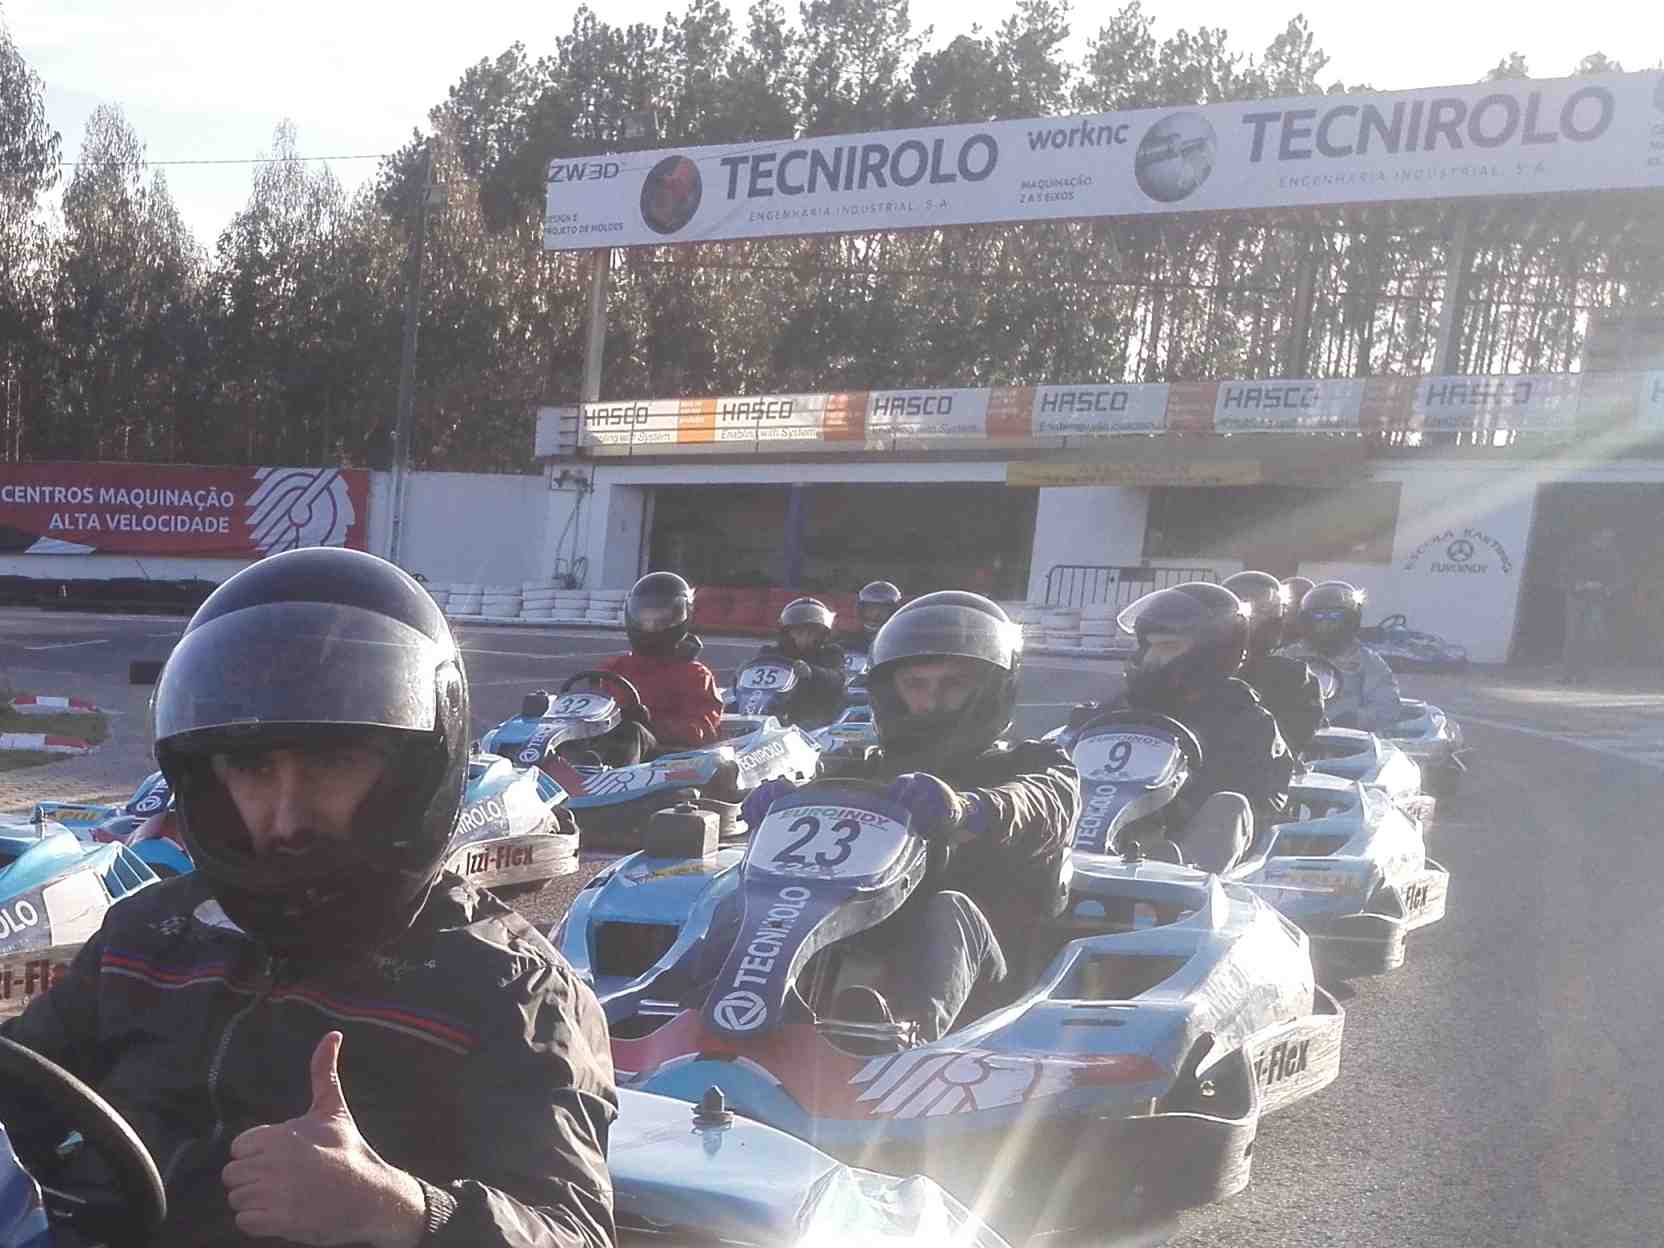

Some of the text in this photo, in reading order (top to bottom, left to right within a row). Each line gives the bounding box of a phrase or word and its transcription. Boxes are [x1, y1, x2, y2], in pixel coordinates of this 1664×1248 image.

[1240, 85, 1617, 163] TECNIROLO
[1027, 120, 1128, 152] worknc
[548, 163, 620, 183] ZW3D
[720, 133, 1000, 201] TECNIROLO
[873, 395, 953, 416] HASCO
[1039, 391, 1130, 412] HASCO
[1224, 386, 1318, 409] HASCO
[584, 405, 649, 427] HASCO
[722, 400, 794, 421] HASCO
[0, 485, 235, 509] CENTROS MAQUINAÇÃO
[48, 512, 230, 534] ALTA VELOCIDADE
[751, 668, 778, 685] 35
[559, 698, 590, 714] 32
[1104, 741, 1132, 773] 9
[771, 815, 862, 866] 23
[733, 886, 811, 987] TECNIOLO
